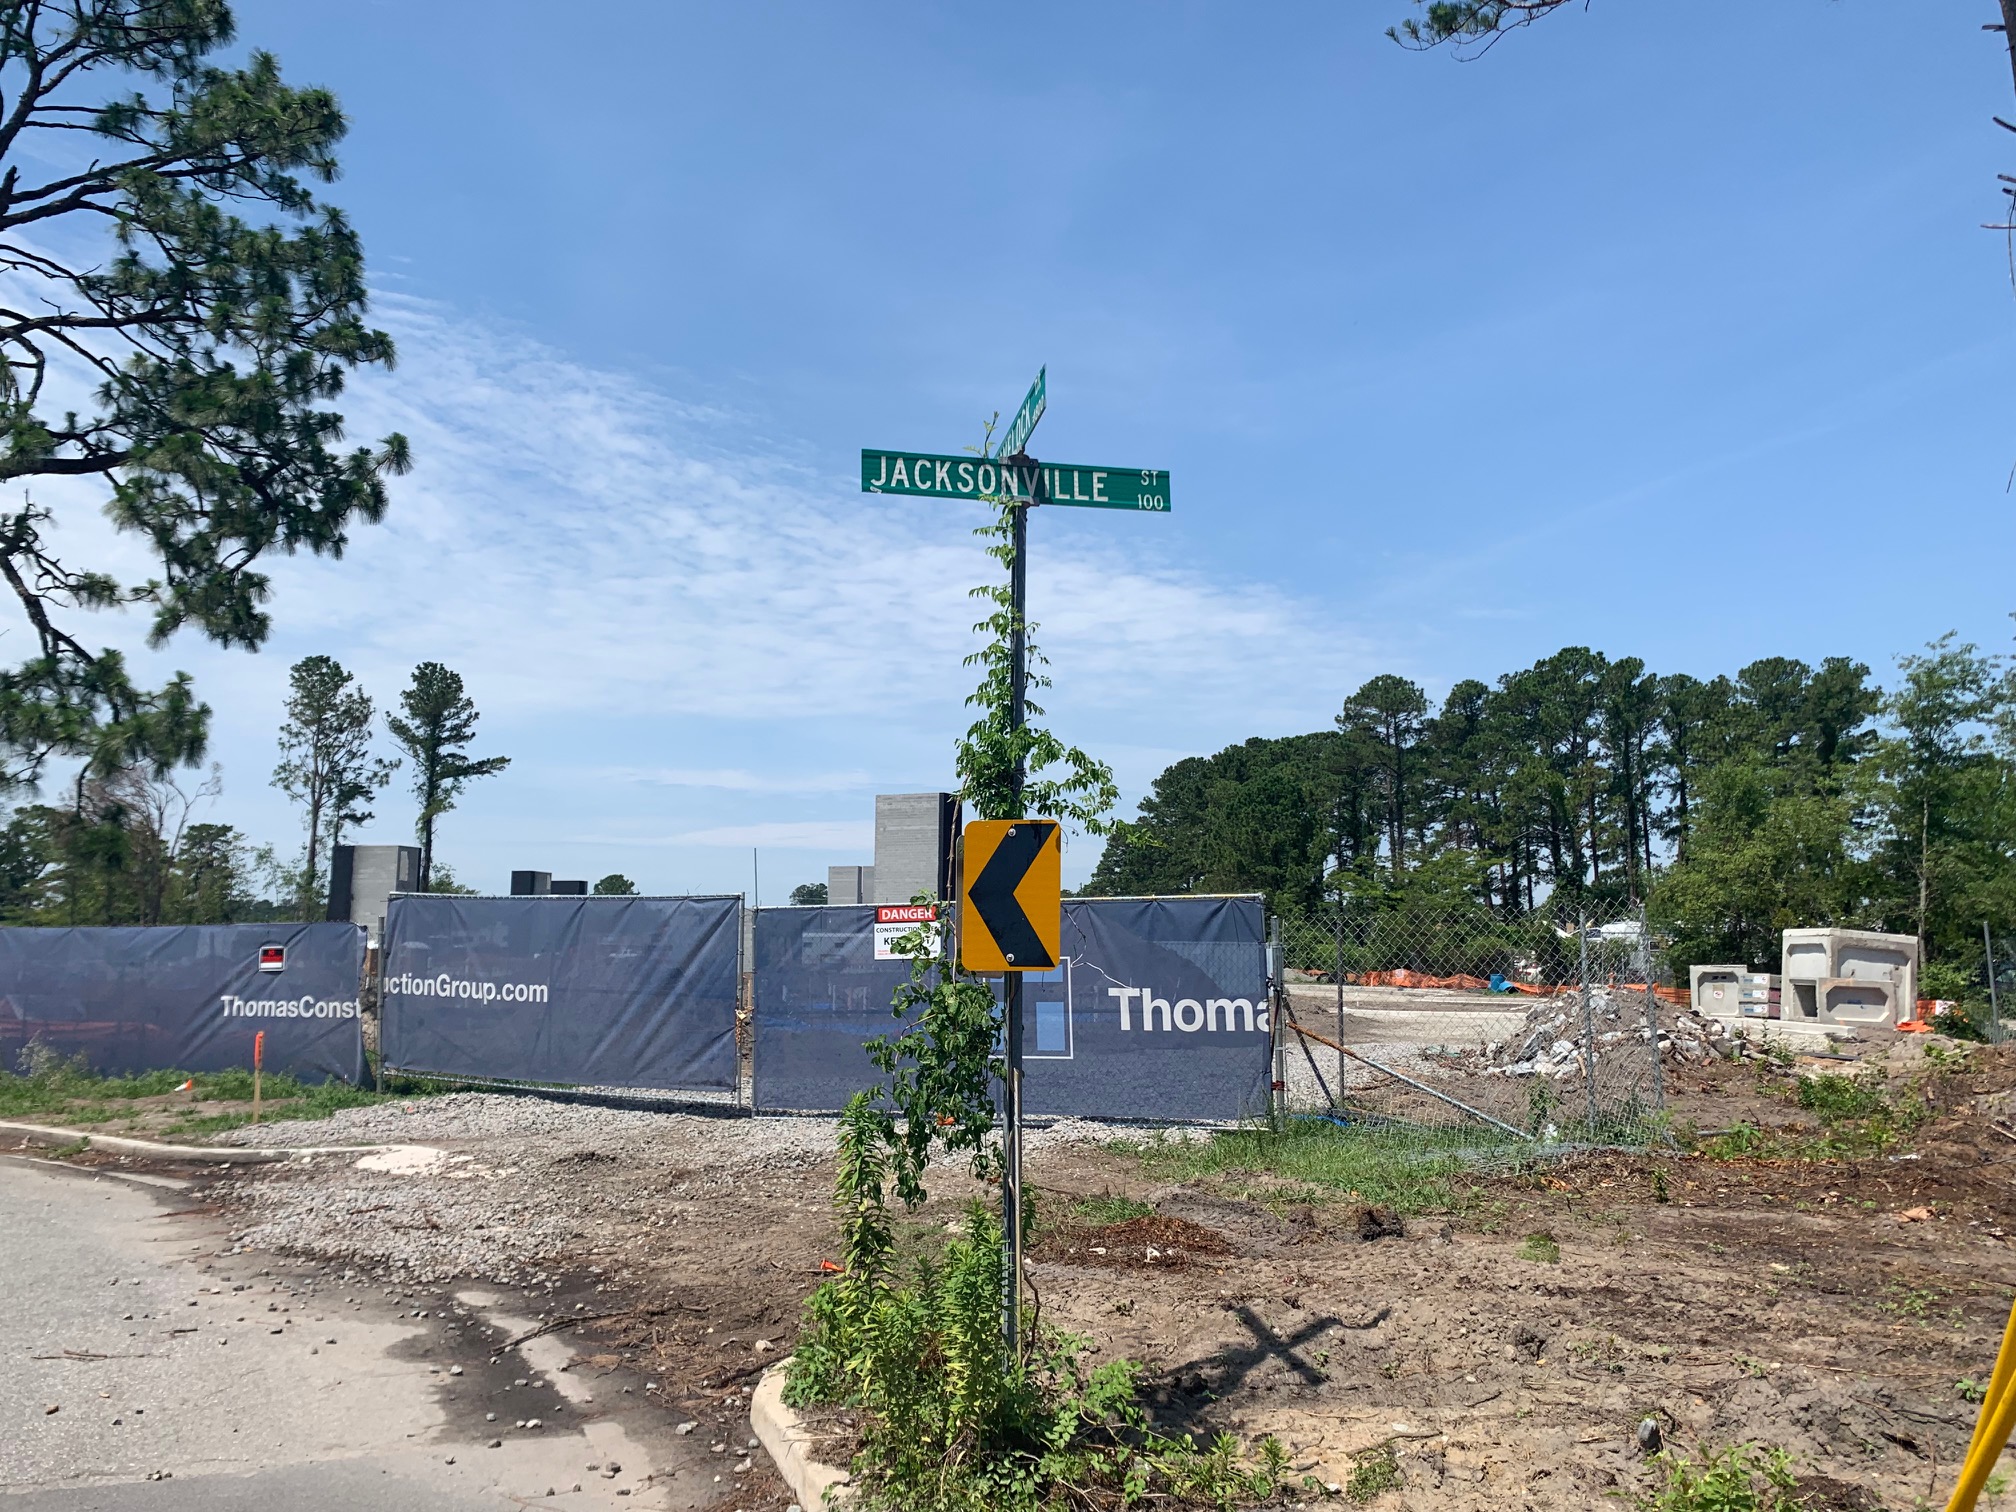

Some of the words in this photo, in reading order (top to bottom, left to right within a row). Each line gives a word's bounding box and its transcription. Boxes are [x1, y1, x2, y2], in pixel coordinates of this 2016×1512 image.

[999, 399, 1031, 457] VELOCK
[870, 456, 1109, 502] JACKSONVILLE
[1140, 470, 1159, 487] ST
[1138, 493, 1164, 511] 100
[881, 908, 933, 920] DANGER
[220, 995, 362, 1019] ThomasConst
